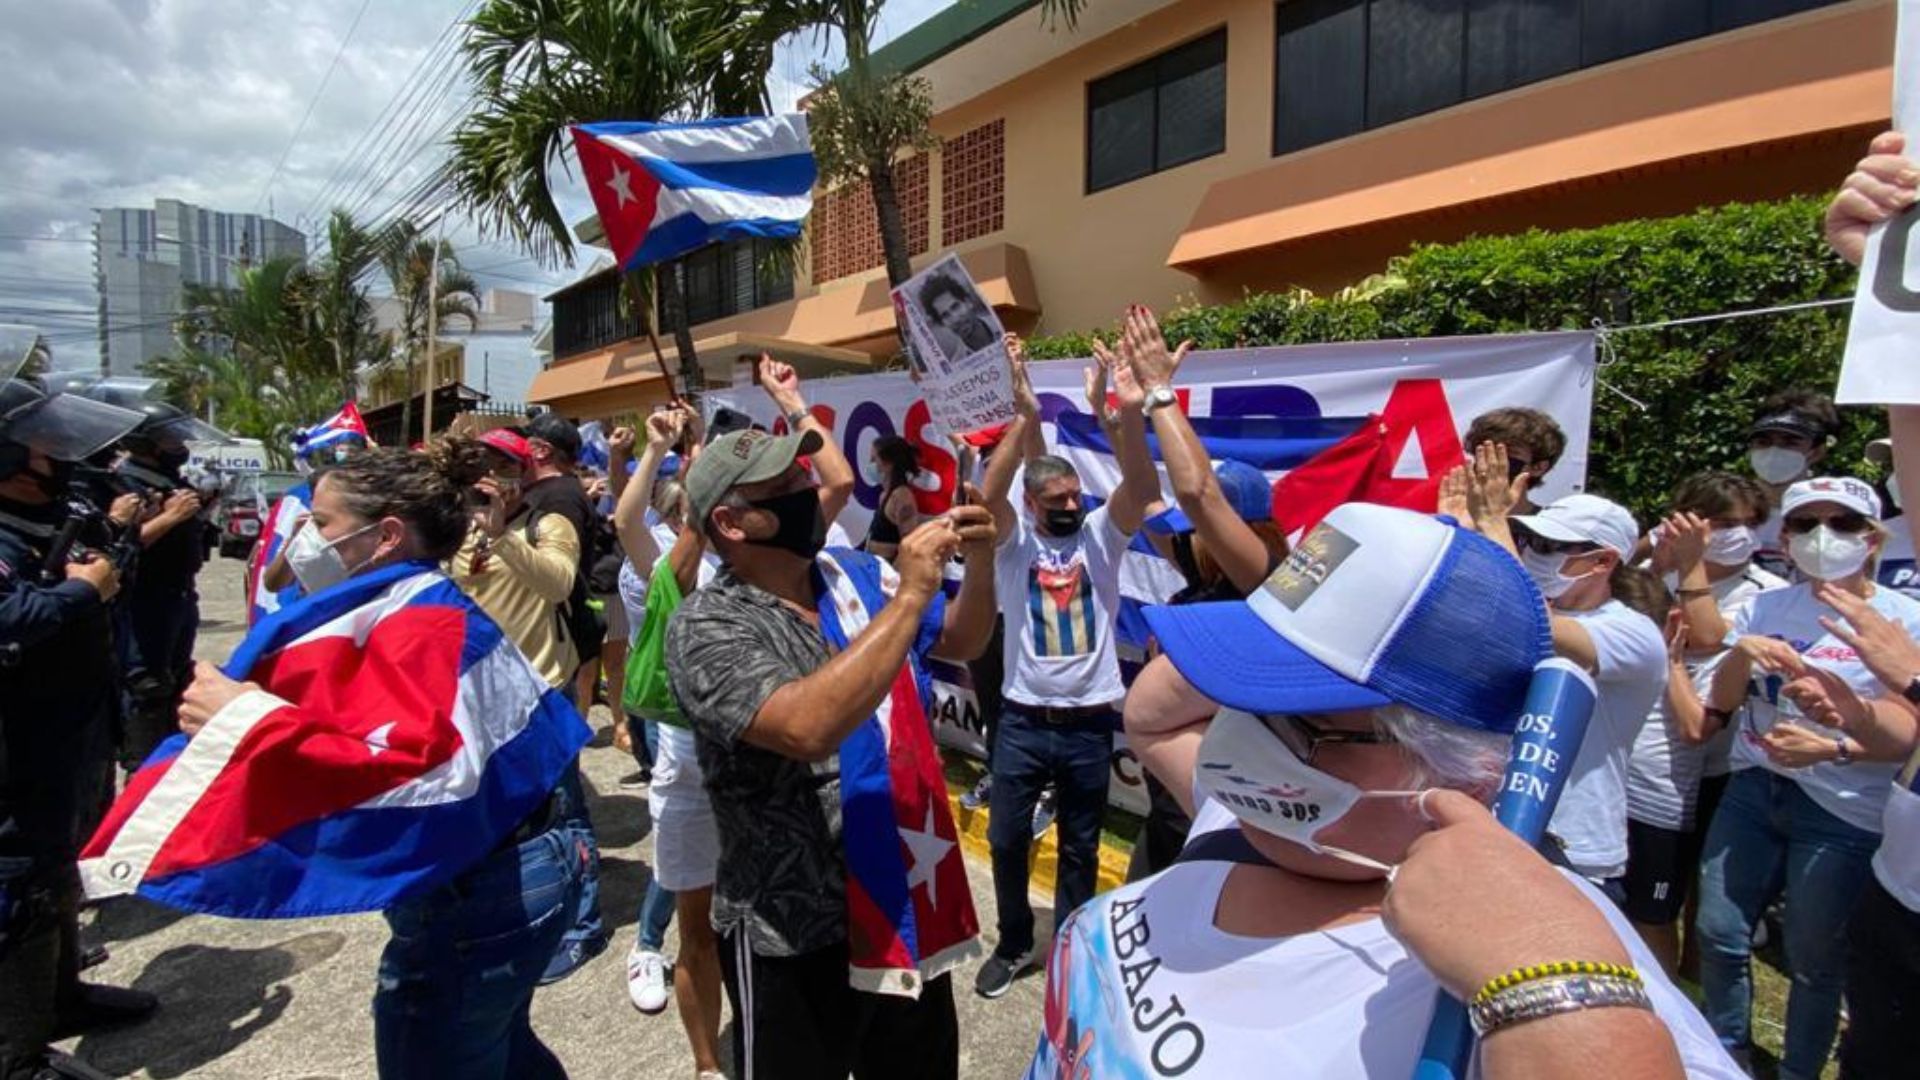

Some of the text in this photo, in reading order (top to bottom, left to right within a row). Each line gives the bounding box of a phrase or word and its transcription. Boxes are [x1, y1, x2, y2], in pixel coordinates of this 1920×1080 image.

[191, 457, 261, 468] PLICIA
[770, 400, 958, 516] OS
[1515, 714, 1557, 739] OS,
[1519, 742, 1560, 773] DE
[1508, 772, 1549, 802] EN
[1653, 882, 1670, 900] 10
[1111, 897, 1205, 1077] ABAJO
